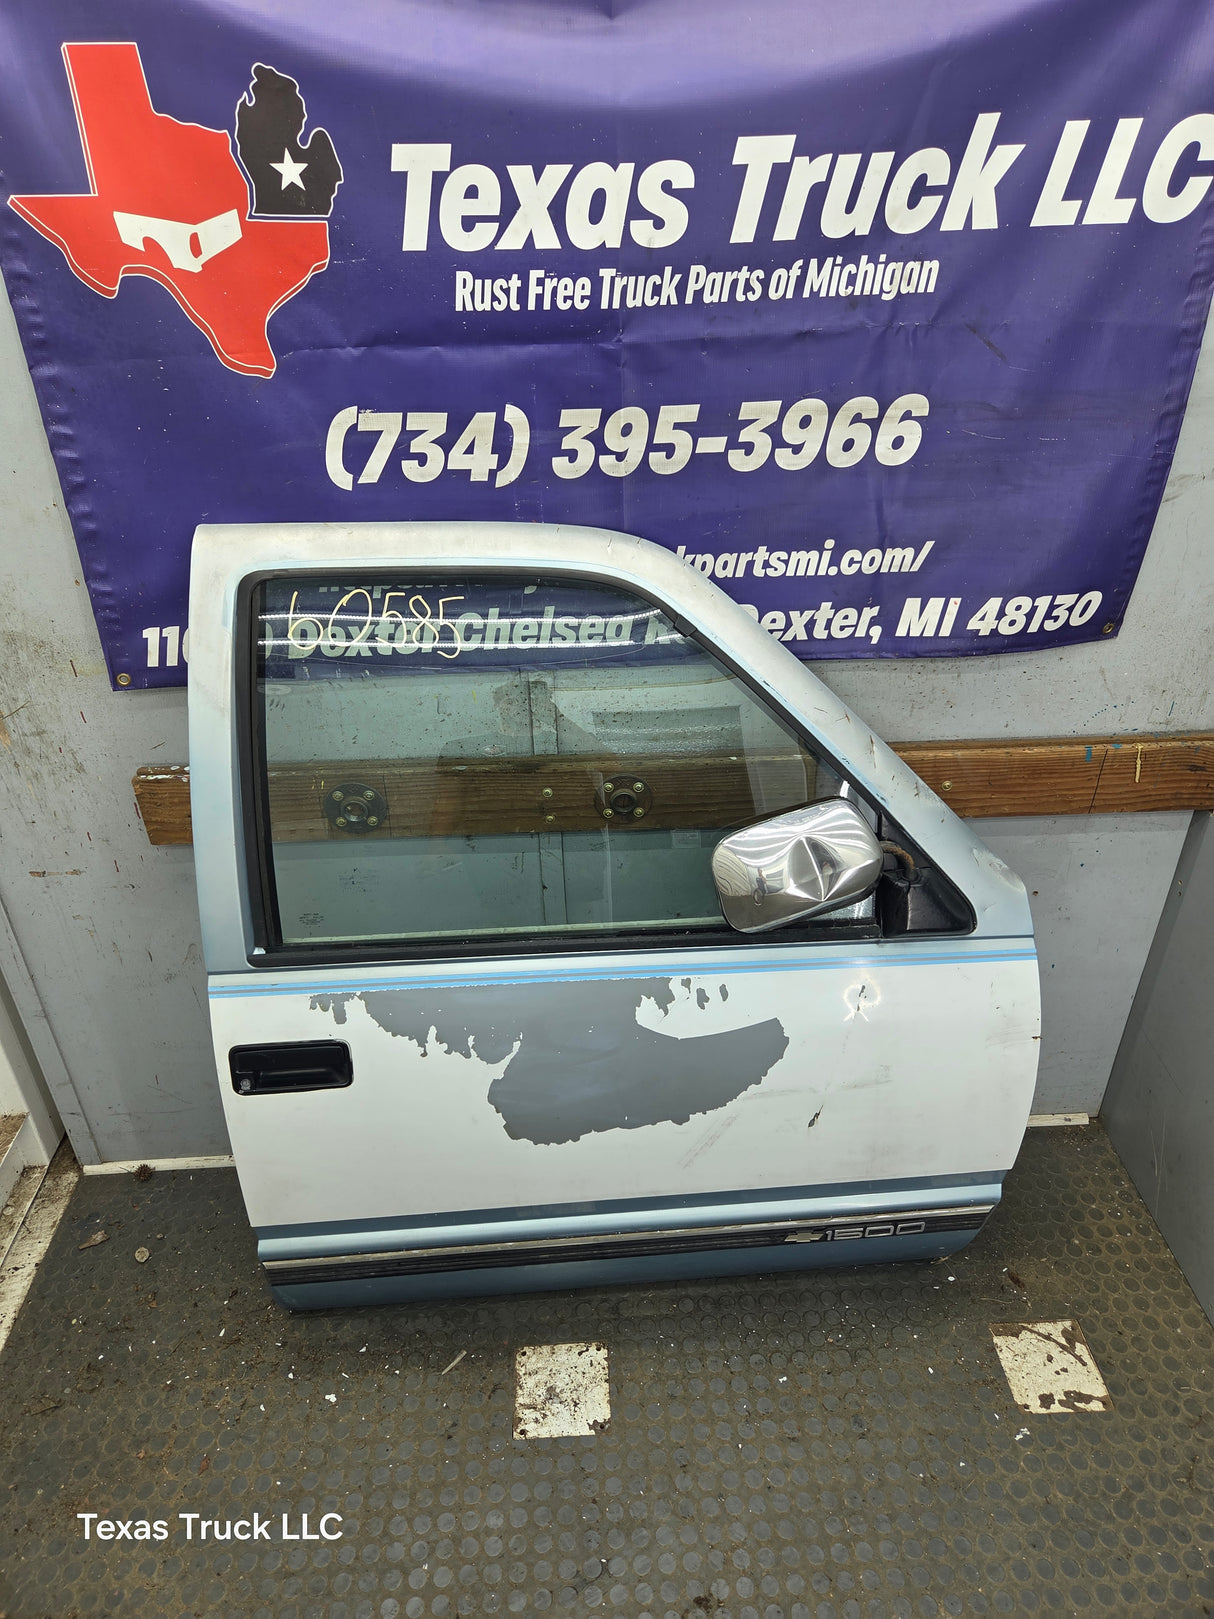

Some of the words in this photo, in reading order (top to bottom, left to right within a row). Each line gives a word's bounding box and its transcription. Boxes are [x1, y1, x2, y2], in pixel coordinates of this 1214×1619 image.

[391, 143, 695, 252] Texas
[730, 112, 1026, 244] Truck
[1030, 113, 1214, 227] LLC
[455, 271, 523, 312] Rust
[527, 269, 591, 311] Free
[599, 266, 680, 309] Truck
[684, 264, 765, 304] Parts
[768, 259, 802, 299] of
[802, 254, 940, 301] Michigan
[325, 403, 531, 491] (734)
[551, 393, 930, 480] 395-3966
[454, 606, 632, 652] Chelsea
[737, 602, 882, 645] exter,
[895, 597, 961, 637] MI
[966, 590, 1103, 636] 48130
[825, 1221, 926, 1241] 1500
